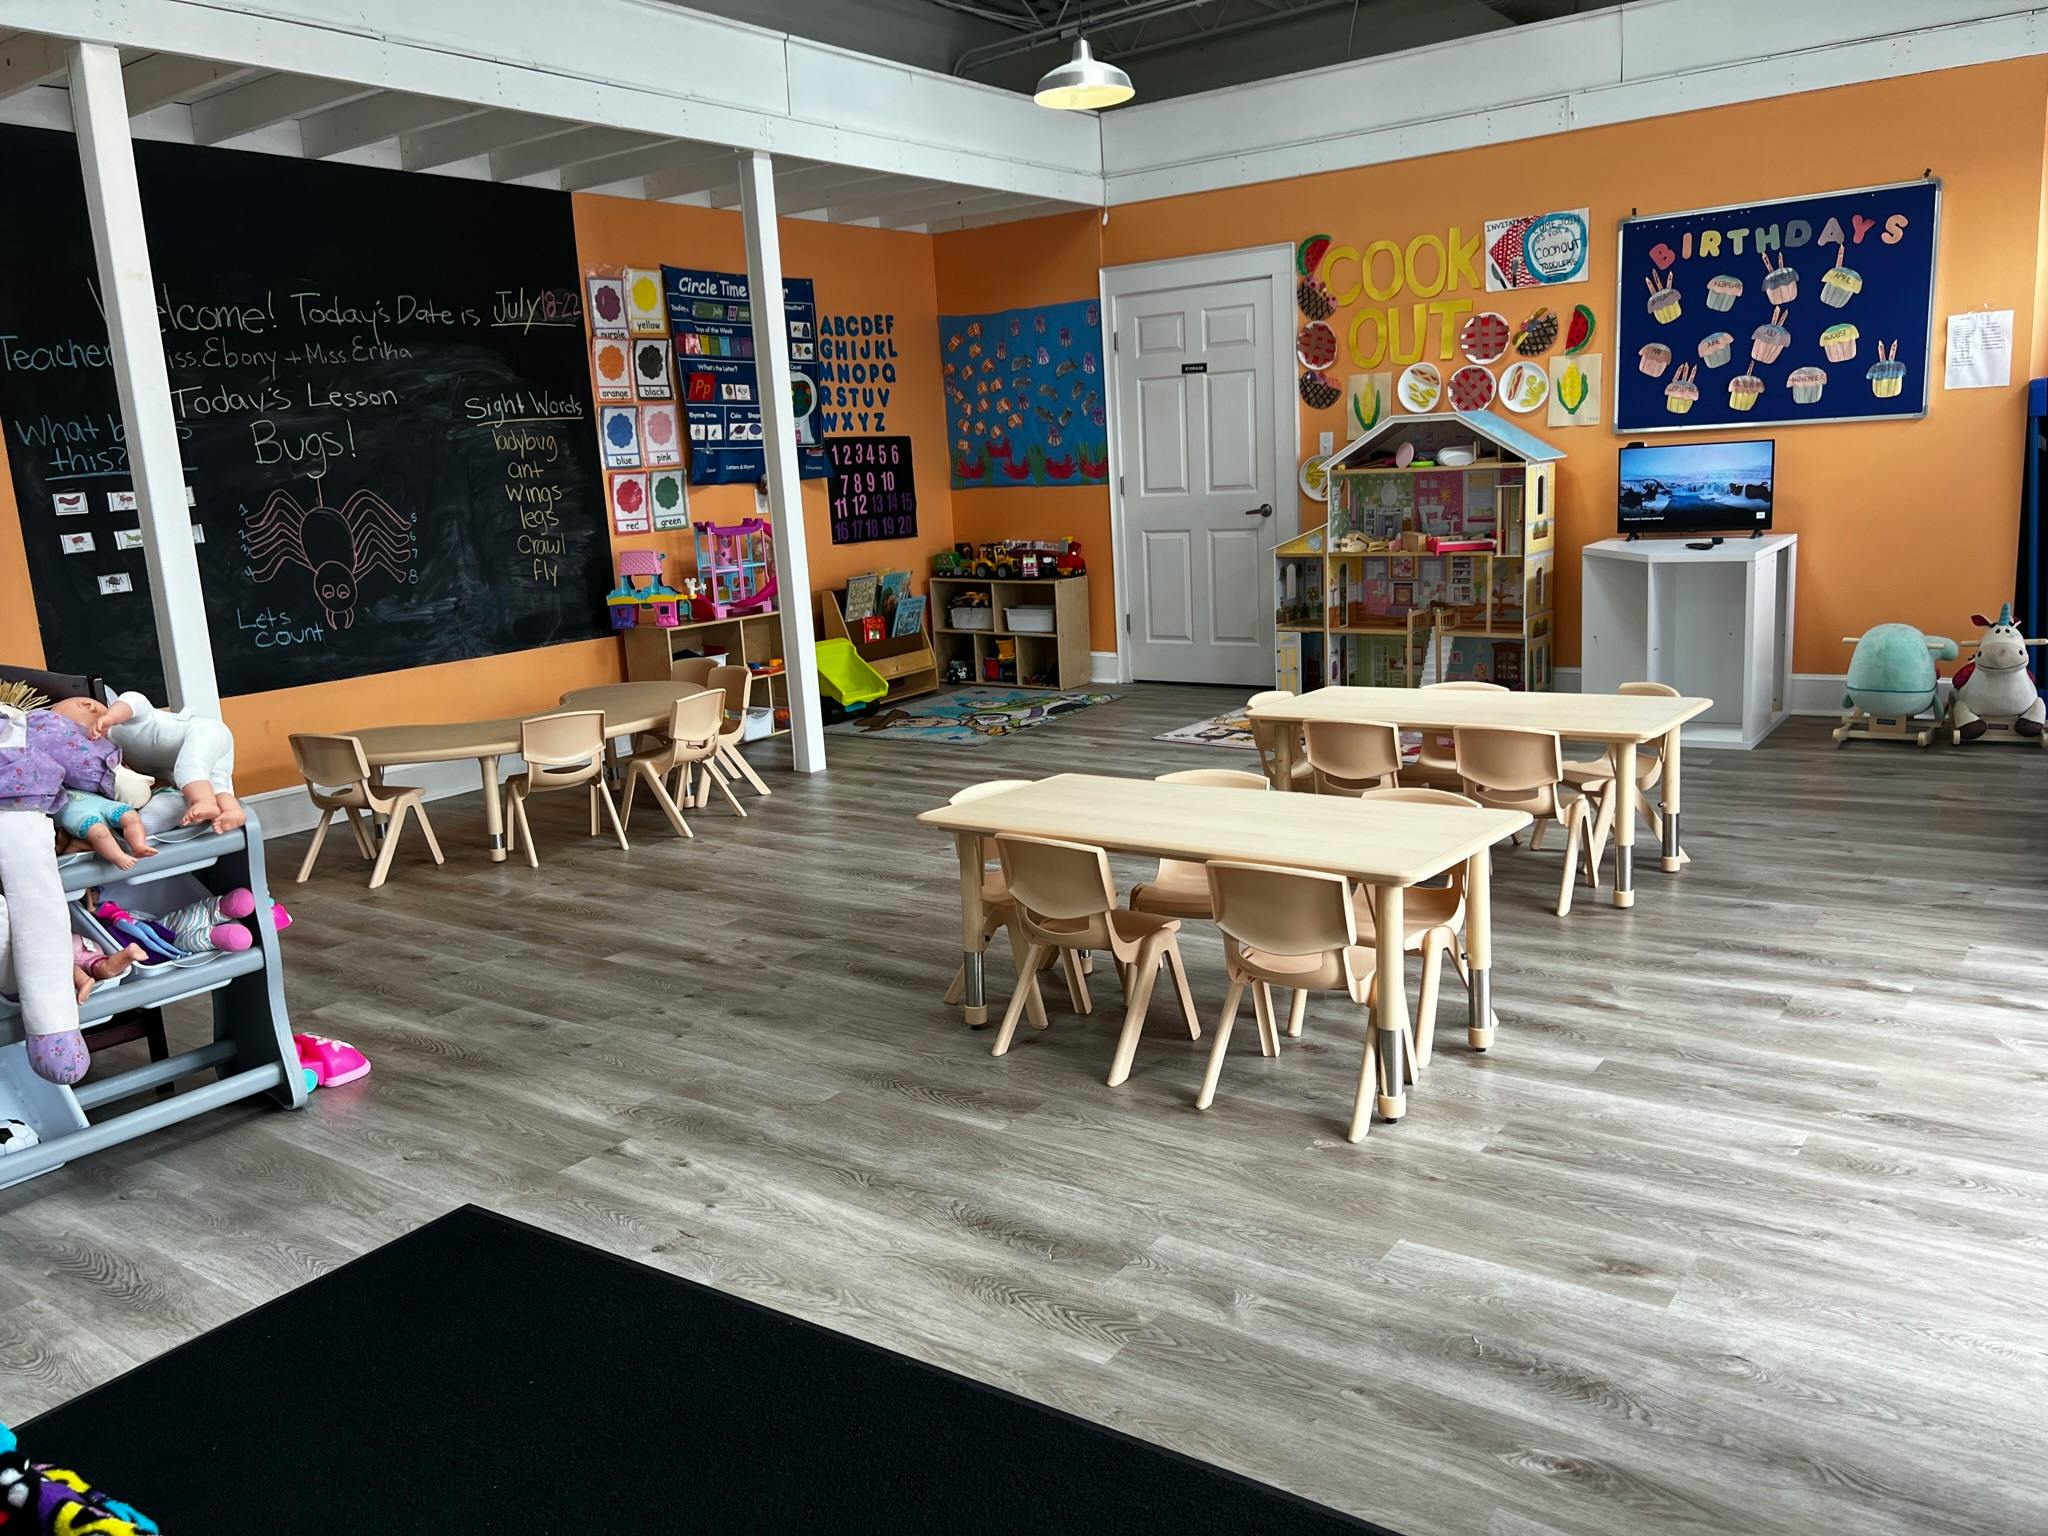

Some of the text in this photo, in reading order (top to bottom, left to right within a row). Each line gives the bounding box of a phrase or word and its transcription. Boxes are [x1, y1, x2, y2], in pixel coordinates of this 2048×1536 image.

[1649, 214, 1909, 270] BIRTHDAYS
[1322, 227, 1481, 307] COOK
[1834, 272, 1851, 284] APRIL
[679, 277, 747, 298] Circle Time
[87, 277, 277, 334] lcome!
[290, 292, 391, 345] Today's
[397, 294, 454, 327] Date
[461, 306, 481, 326] is
[493, 287, 541, 335] July
[637, 321, 660, 331] yellow
[1348, 299, 1473, 369] OUT
[167, 349, 201, 369] iss.
[203, 336, 277, 381] Ebony
[352, 335, 413, 363] Erika
[170, 381, 398, 419] Today's Lesson
[602, 390, 628, 399] orange
[644, 387, 665, 396] black
[695, 379, 711, 399] Pp
[464, 391, 583, 427] Sight Words
[15, 413, 193, 446] What bs
[250, 419, 357, 479] Bugs!
[492, 429, 558, 462] ladybug
[832, 445, 839, 465] 1
[843, 445, 852, 465] 2
[855, 443, 863, 464] 3
[866, 444, 875, 465] 4
[878, 444, 887, 465] 5
[891, 444, 899, 465] 6
[49, 446, 127, 474] this?
[508, 460, 545, 479] ant
[616, 456, 633, 465] blue
[656, 453, 672, 464] pink
[840, 471, 895, 495] 7 8 9 10
[835, 491, 913, 519] 11 12 13 14 15
[520, 504, 560, 536] legs
[626, 521, 639, 530] red
[661, 519, 682, 529] green
[835, 515, 912, 542] 16 17 18 19 20
[409, 569, 418, 584] 8
[236, 607, 292, 630] Lets
